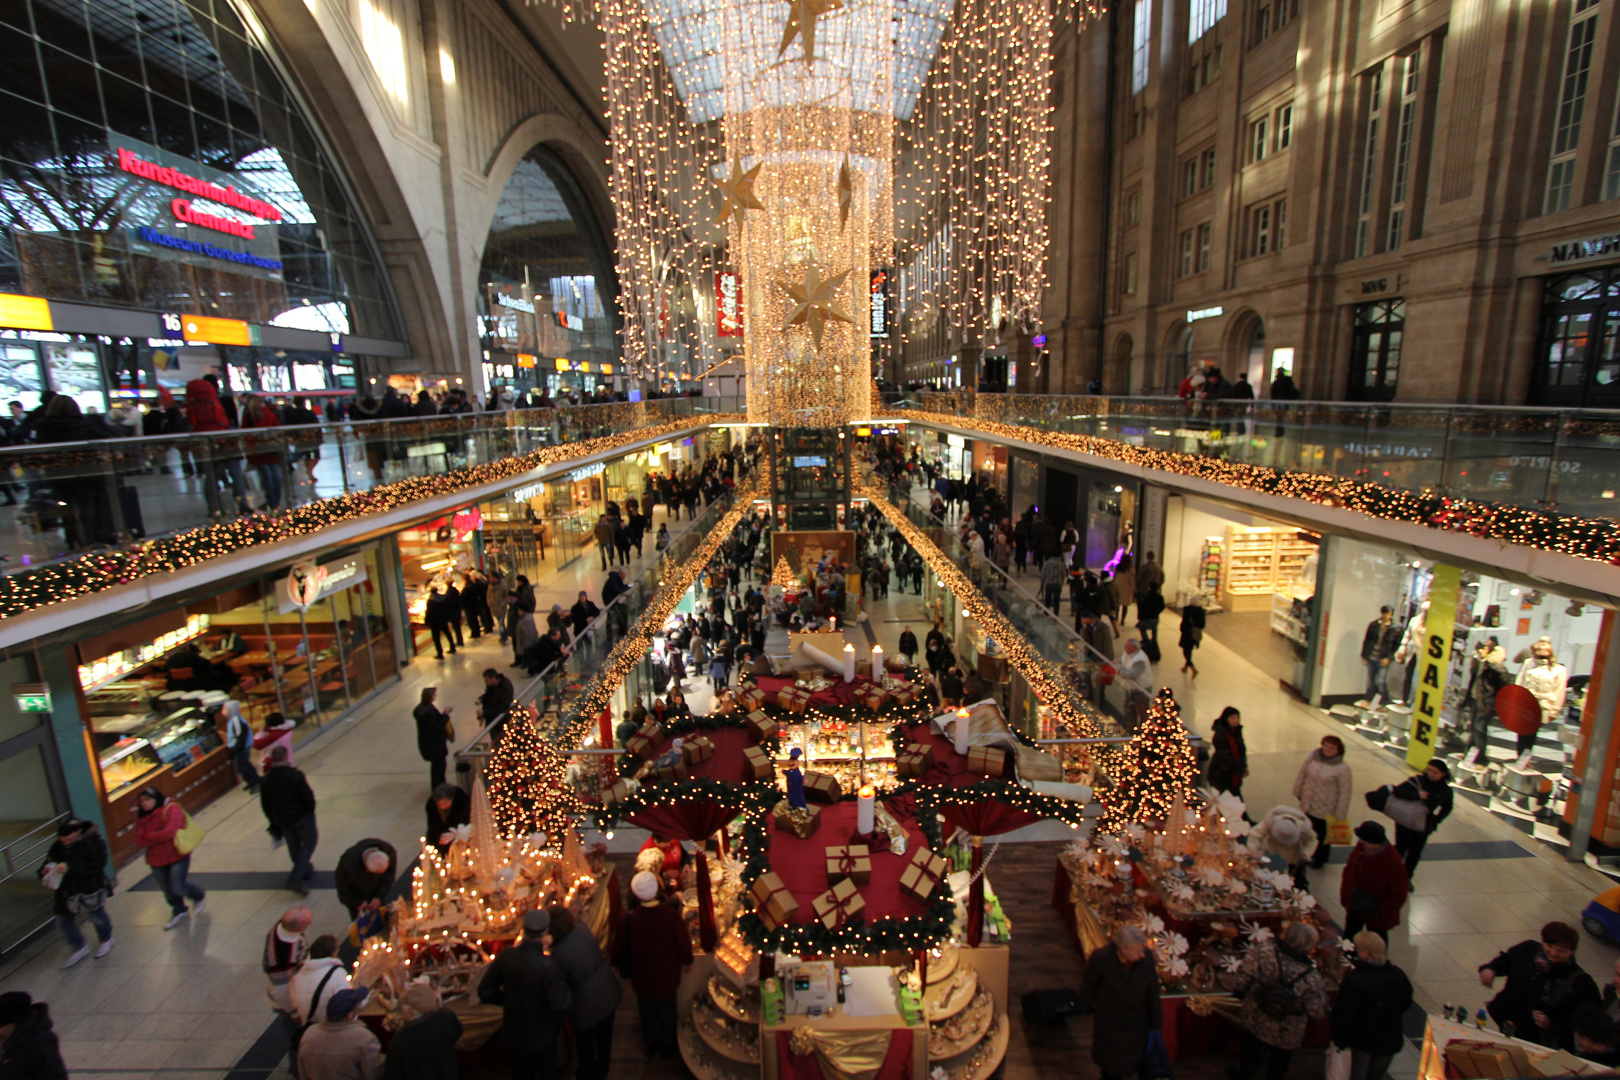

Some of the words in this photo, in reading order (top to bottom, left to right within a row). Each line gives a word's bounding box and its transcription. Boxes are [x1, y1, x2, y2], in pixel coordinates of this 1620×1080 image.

[118, 147, 282, 221] Kunstsammlungen
[171, 198, 255, 240] Chemnitz
[140, 226, 203, 254] Museum
[162, 313, 182, 331] 16
[871, 292, 885, 332] SATURN
[1415, 635, 1444, 746] SALE
